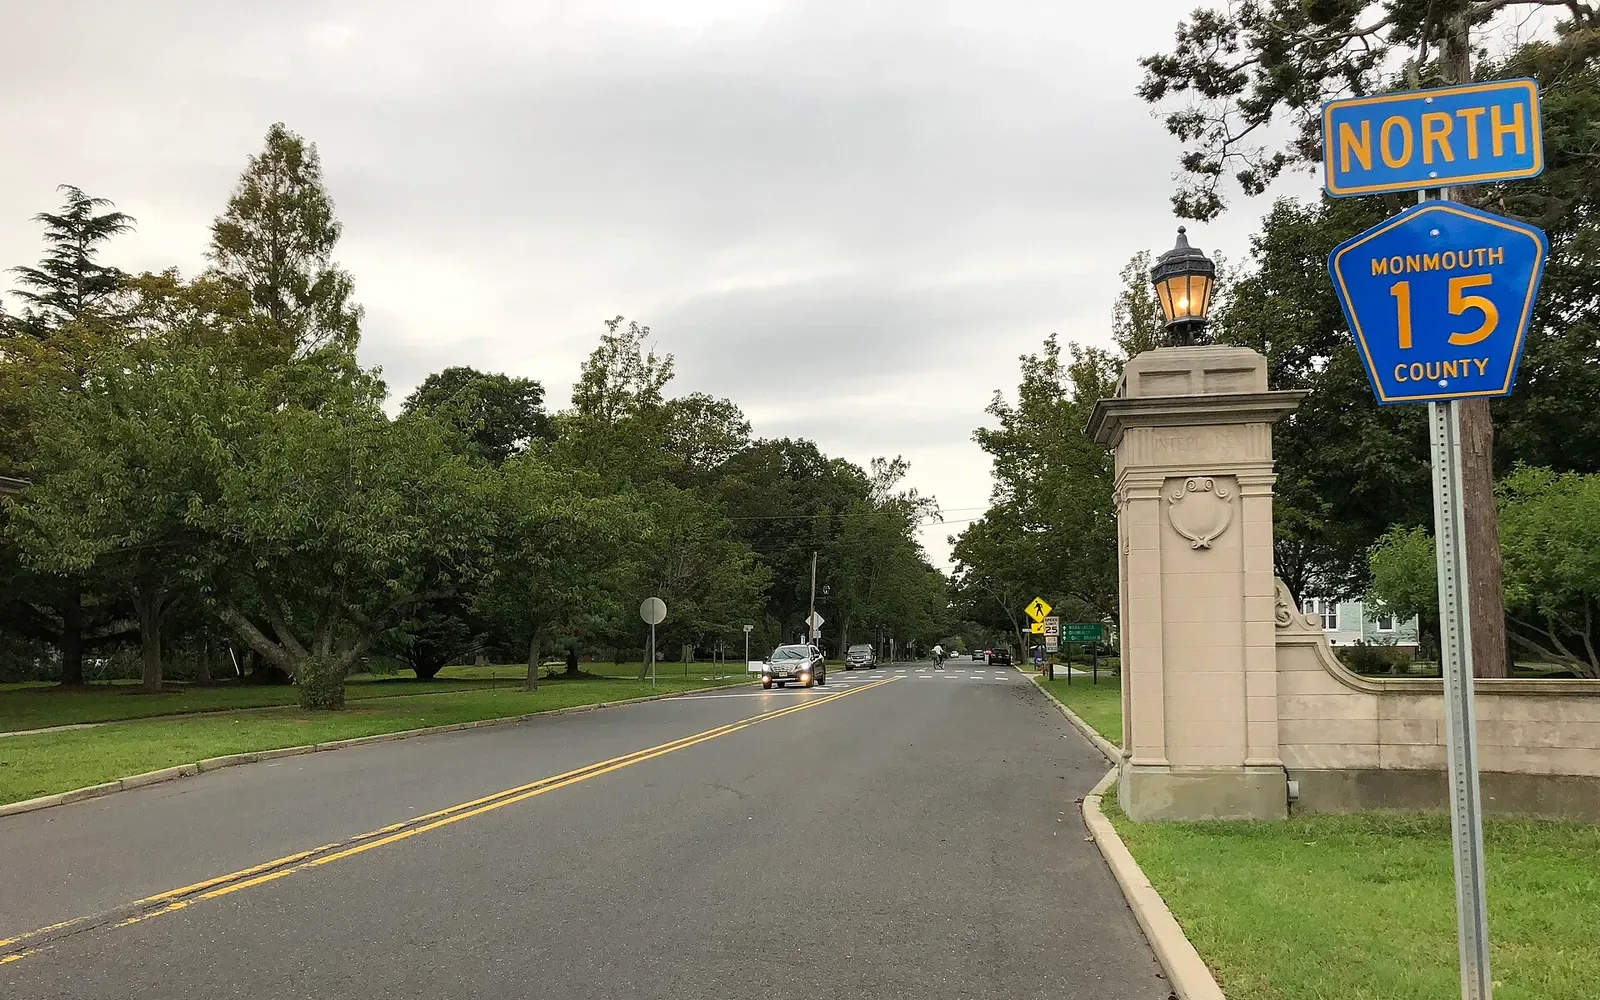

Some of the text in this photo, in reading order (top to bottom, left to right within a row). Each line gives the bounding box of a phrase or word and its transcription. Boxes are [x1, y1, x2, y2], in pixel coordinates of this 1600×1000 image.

[1339, 103, 1526, 173] NORTH
[1371, 246, 1504, 276] MONMOUTH
[1394, 357, 1489, 382] COUNTY
[1045, 626, 1058, 634] 25
